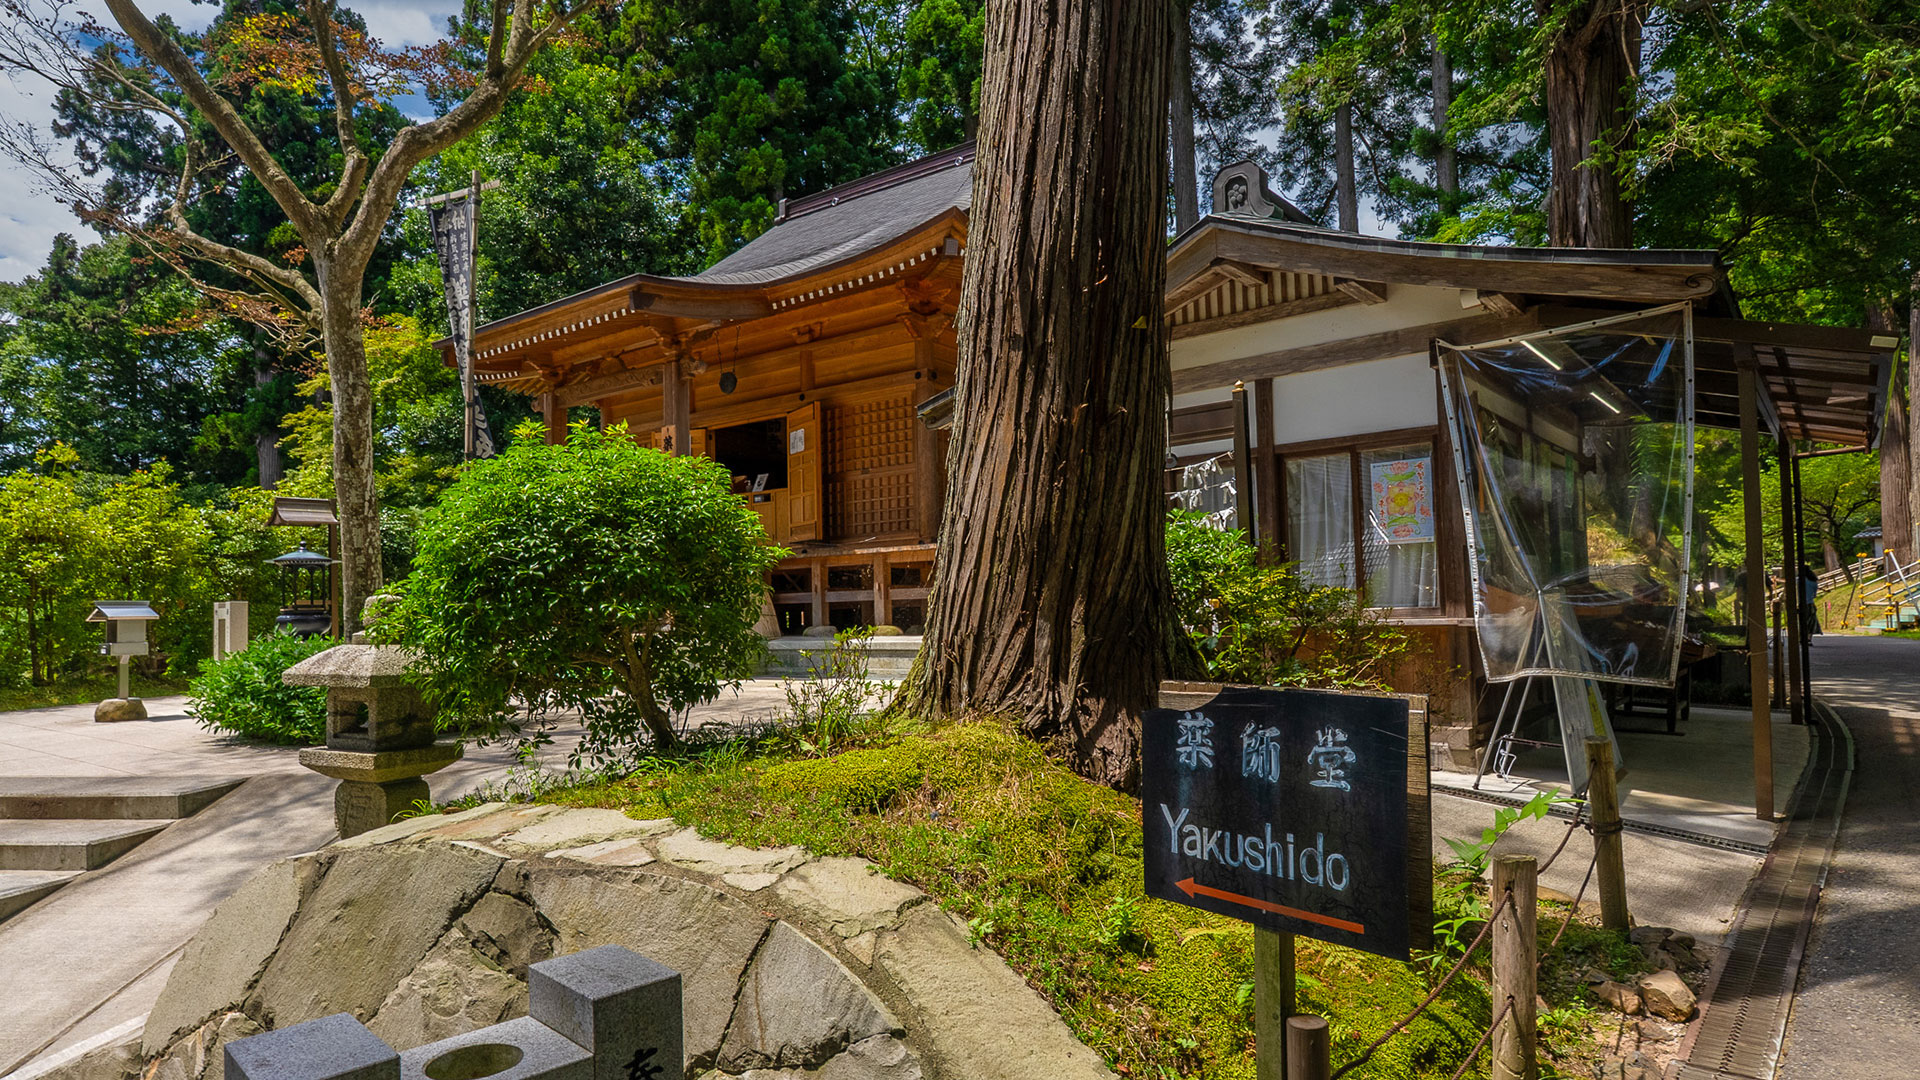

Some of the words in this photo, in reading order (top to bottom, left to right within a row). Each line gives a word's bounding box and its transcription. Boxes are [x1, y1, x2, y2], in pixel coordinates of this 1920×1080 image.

[1176, 712, 1357, 792] 薬師堂
[1160, 803, 1349, 891] Yakushido
